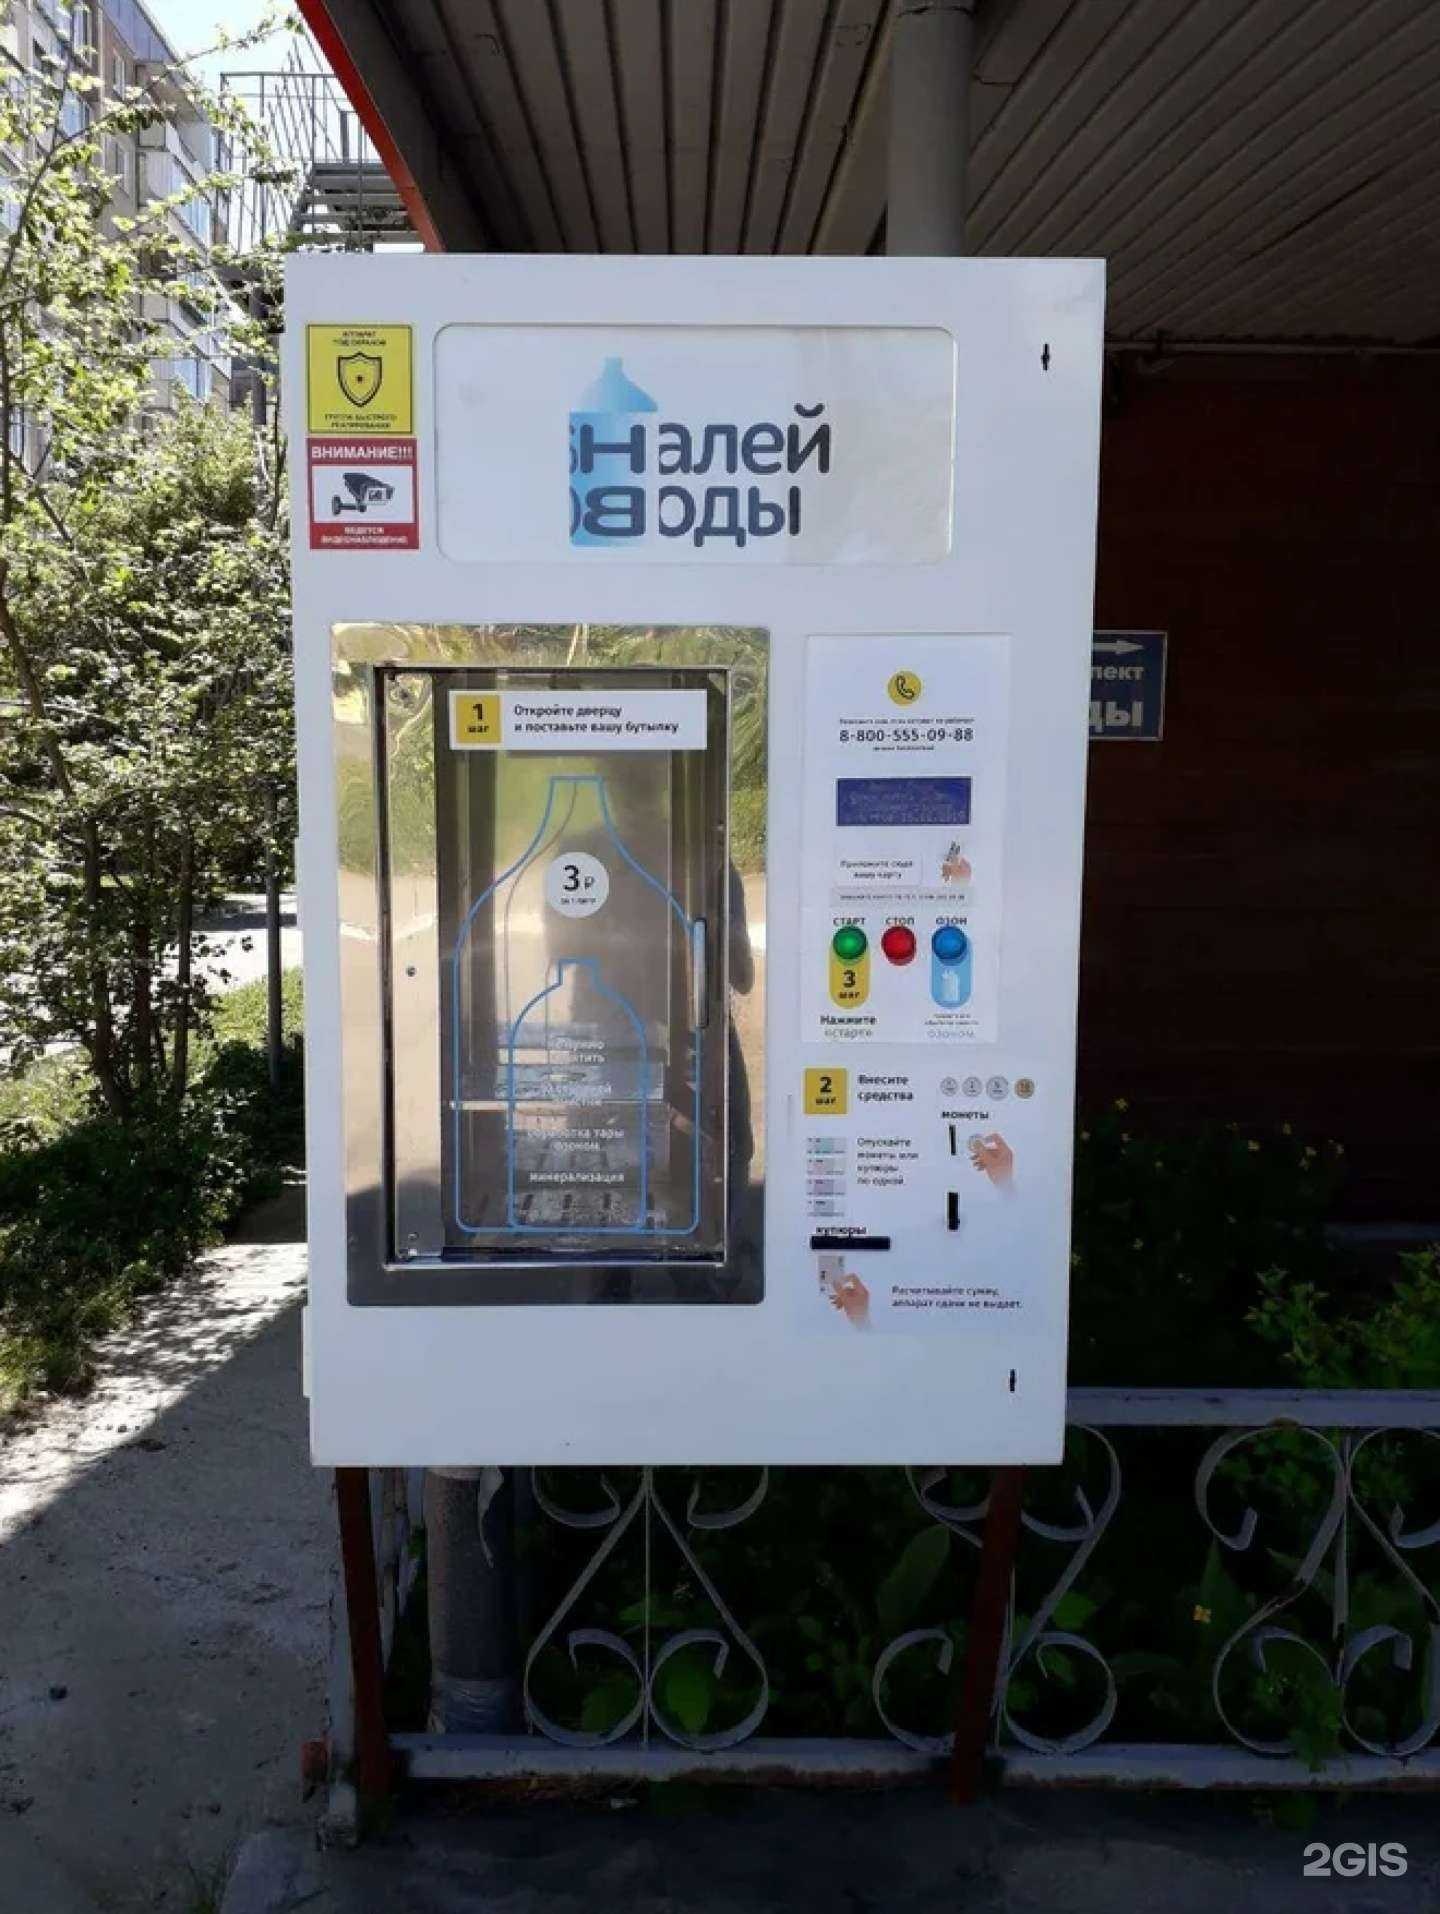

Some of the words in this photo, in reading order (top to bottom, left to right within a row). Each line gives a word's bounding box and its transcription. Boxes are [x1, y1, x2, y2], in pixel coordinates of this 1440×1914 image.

[311, 446, 413, 460] ВНИМАНИЕ!!!
[472, 703, 484, 720] 1
[514, 704, 574, 718] Откройте
[576, 707, 622, 718] дверцу
[467, 725, 489, 733] шаг
[514, 723, 522, 732] и
[525, 722, 588, 733] поставьте
[591, 723, 622, 735] вашу
[625, 721, 679, 735] бутылку
[839, 728, 974, 743] 8-800-555-09-88
[563, 864, 580, 892] 3
[832, 916, 866, 926] СТАРТ
[885, 916, 915, 926] СТОП
[842, 969, 857, 988] 3
[820, 1015, 877, 1026] Нажмите
[819, 1076, 833, 1093] 2
[857, 1074, 908, 1086] Внесите
[815, 1097, 836, 1106] шаг
[857, 1090, 914, 1103] средства
[941, 1111, 990, 1120] монеты
[857, 1136, 911, 1149] Опускайте
[529, 1171, 625, 1184] минерализация
[968, 1300, 981, 1308] не
